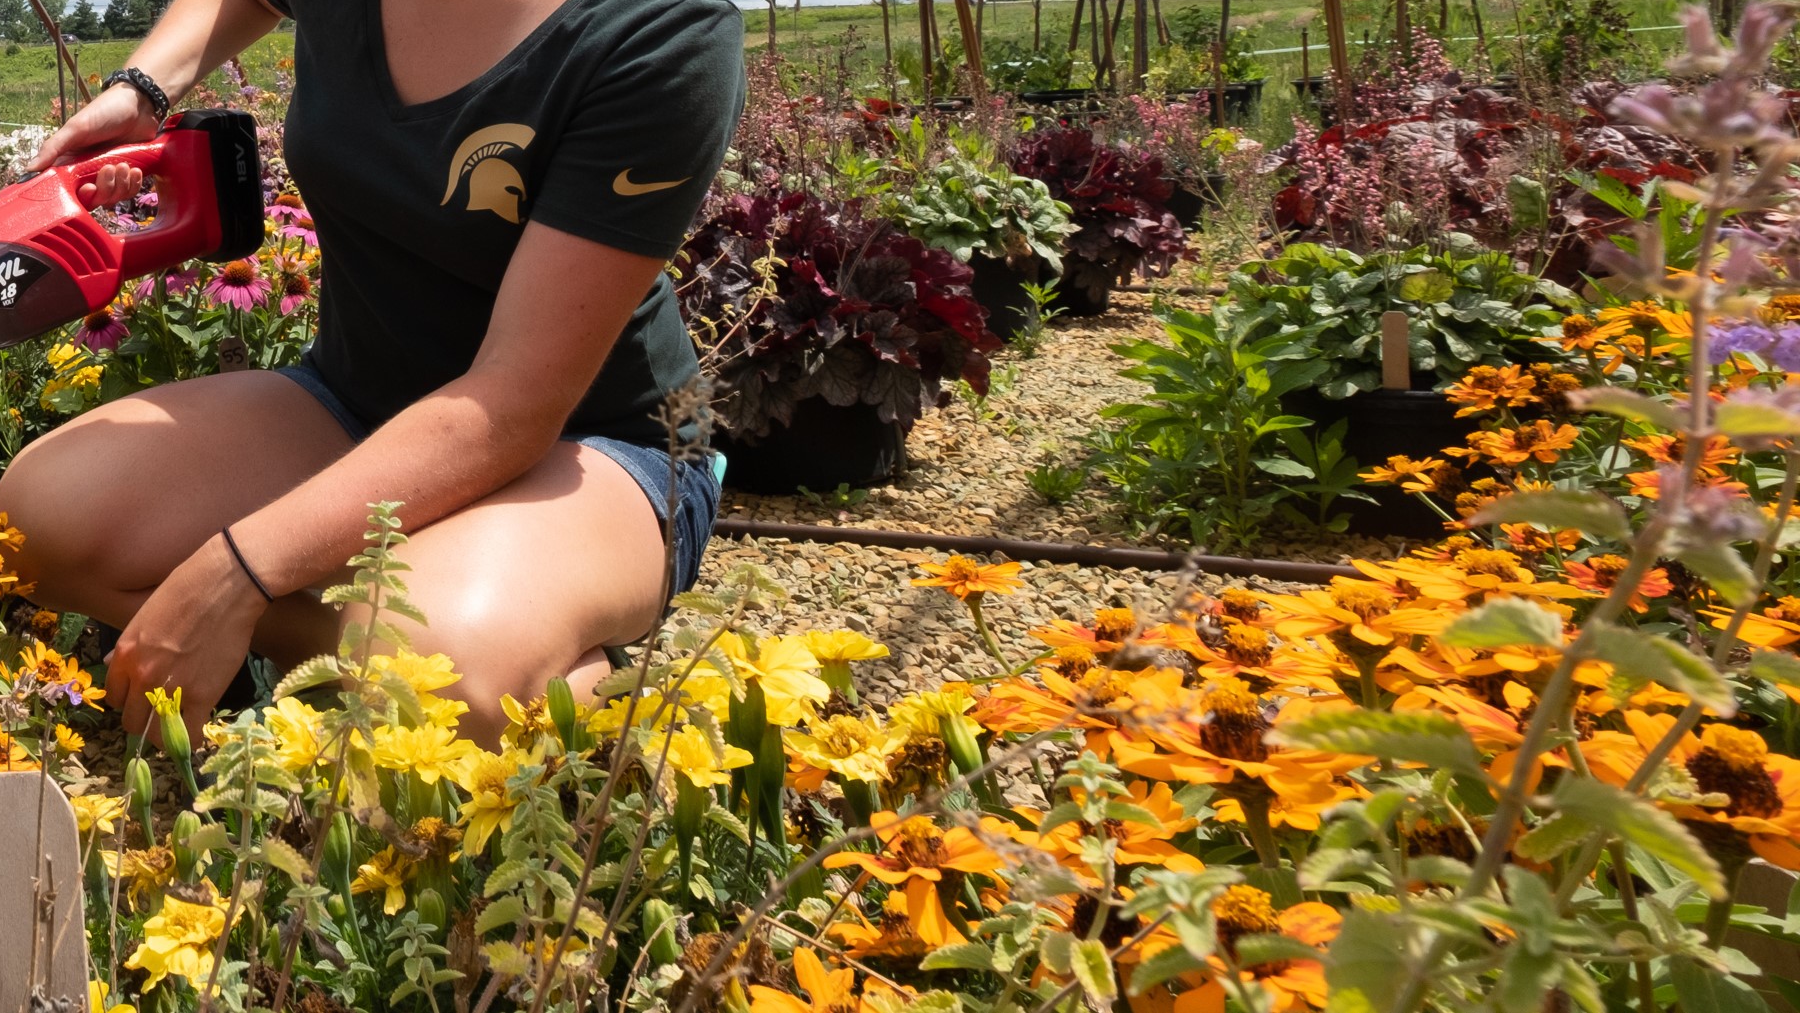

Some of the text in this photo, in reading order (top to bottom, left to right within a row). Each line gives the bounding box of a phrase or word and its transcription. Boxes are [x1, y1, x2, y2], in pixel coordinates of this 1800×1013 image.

[234, 142, 247, 183] 18V
[0, 282, 17, 301] 18
[2, 297, 15, 307] VOLT
[221, 346, 244, 364] 55
